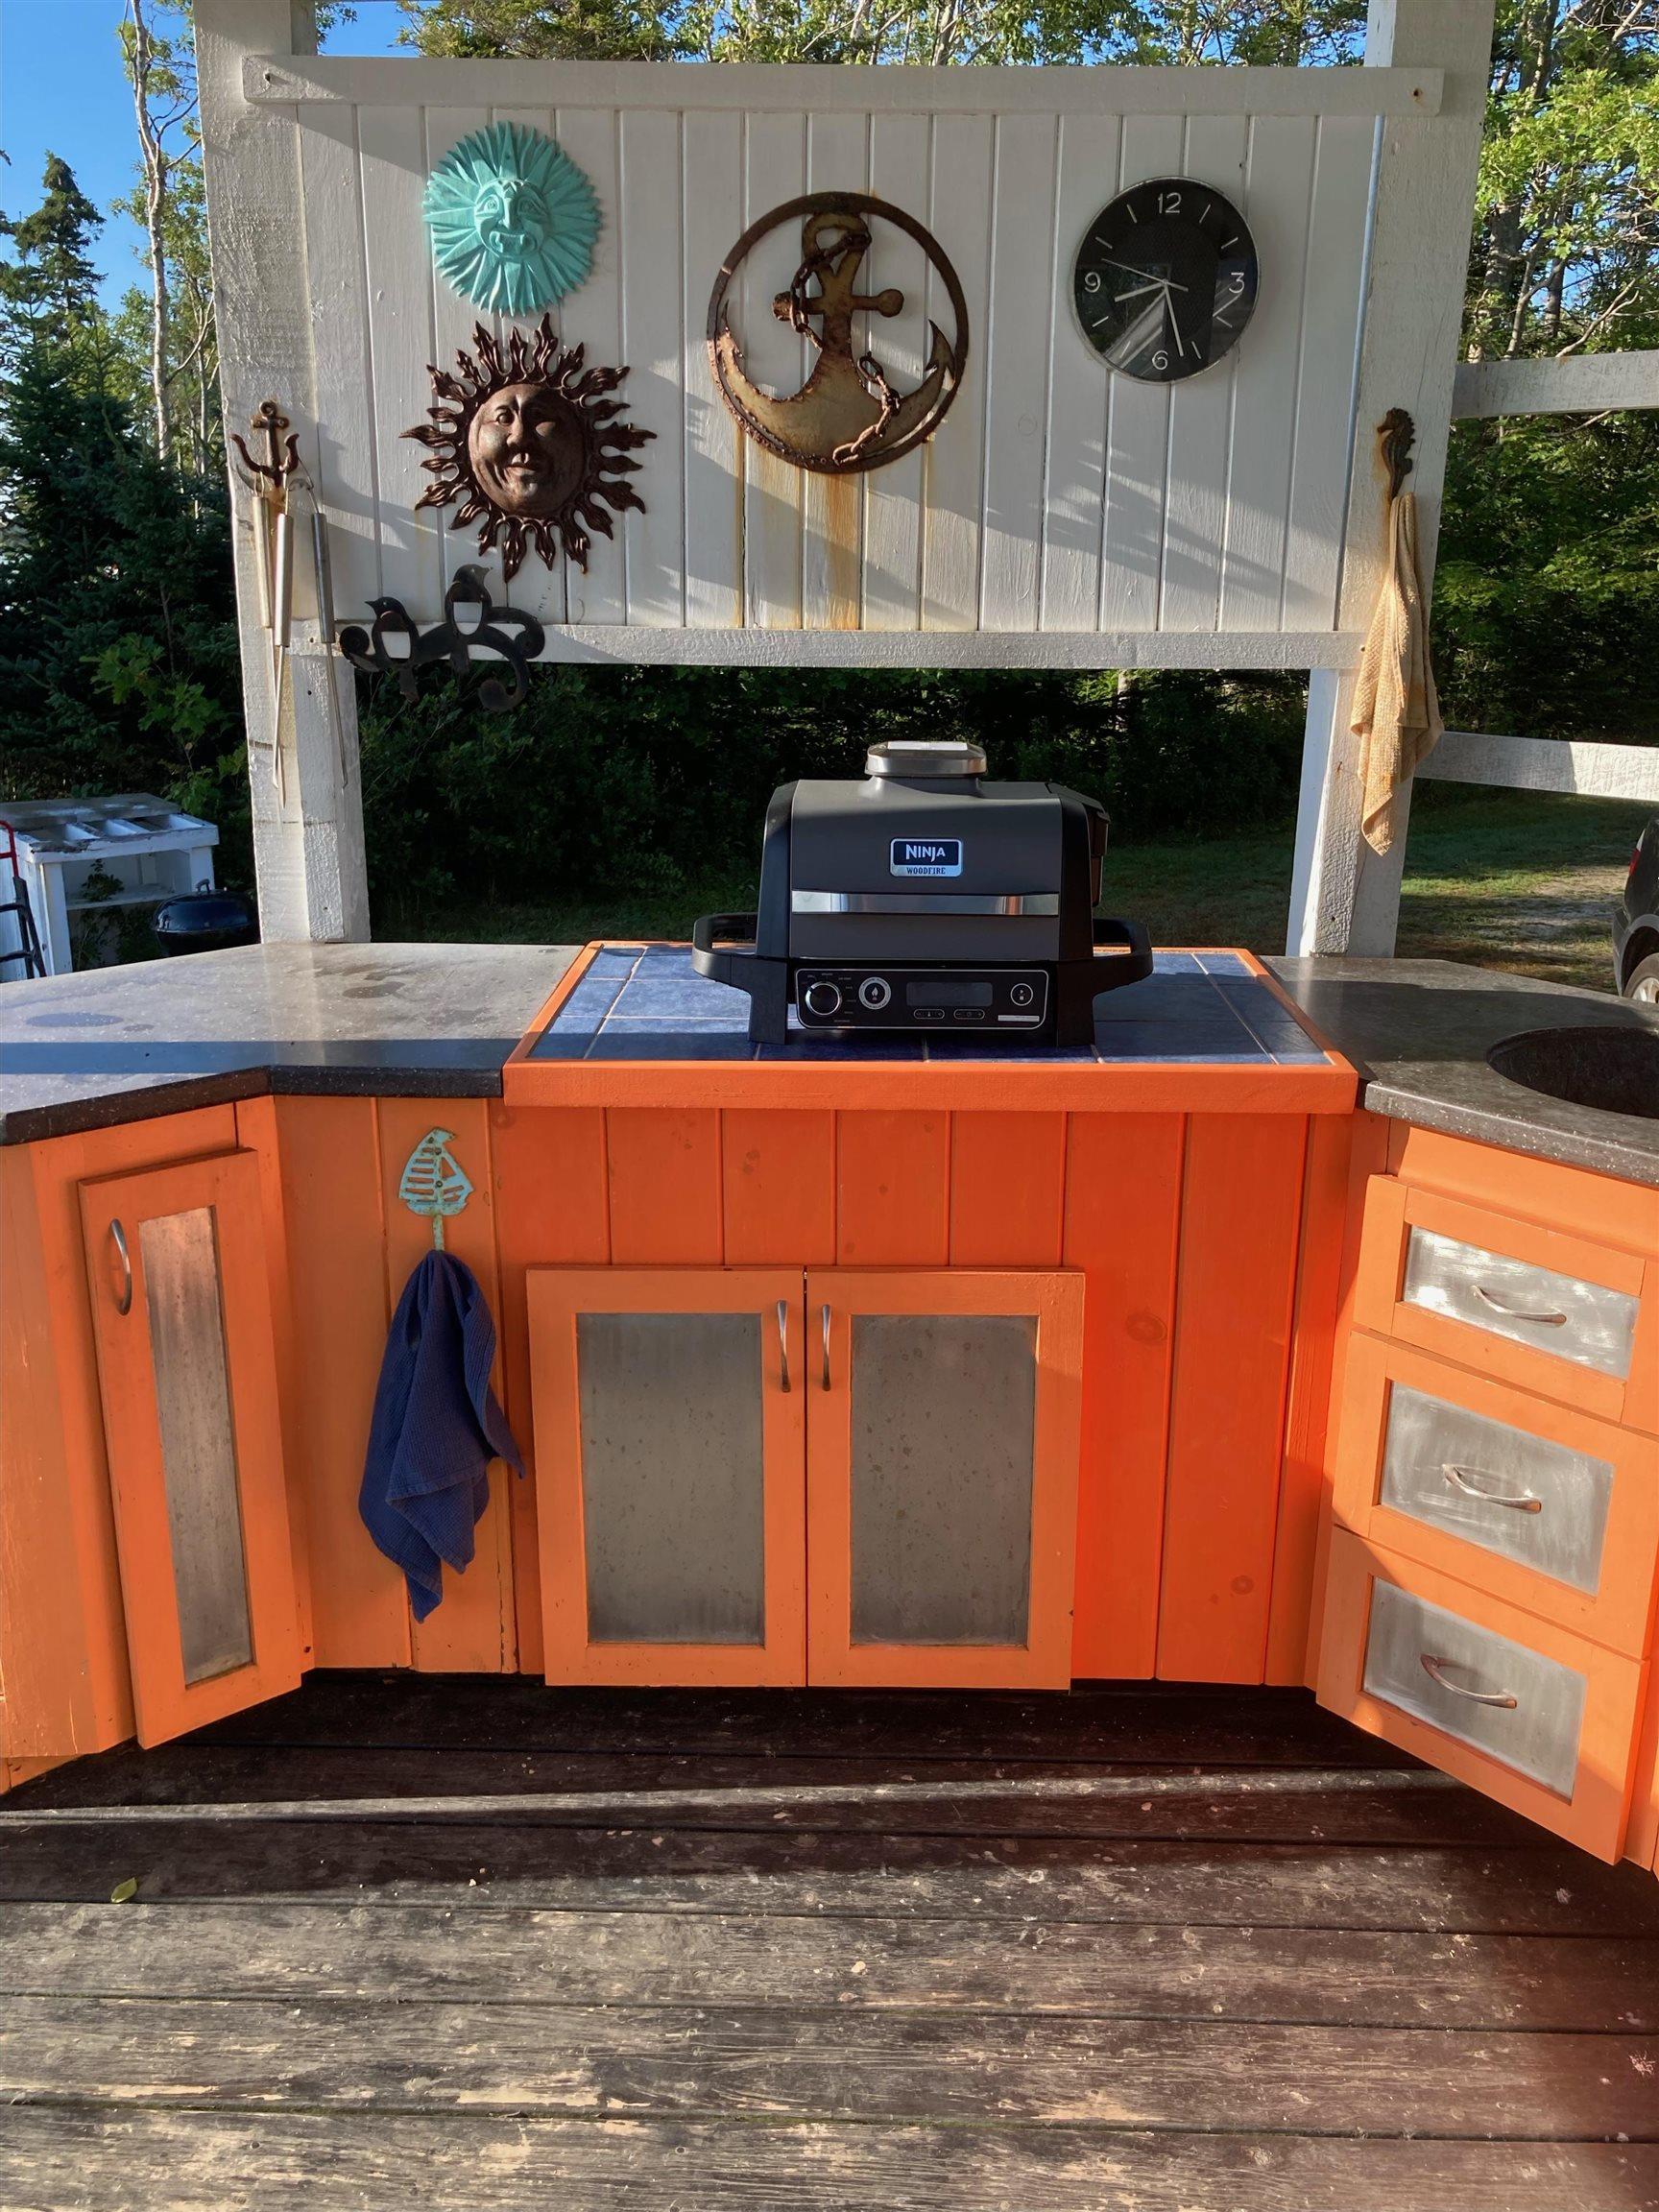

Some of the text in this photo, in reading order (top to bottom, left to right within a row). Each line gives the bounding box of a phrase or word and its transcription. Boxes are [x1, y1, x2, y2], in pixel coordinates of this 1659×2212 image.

[1158, 193, 1182, 214] 12
[1084, 272, 1101, 293] 9
[1228, 272, 1245, 294] 3
[1151, 350, 1168, 371] 6
[905, 844, 946, 862] NINJA
